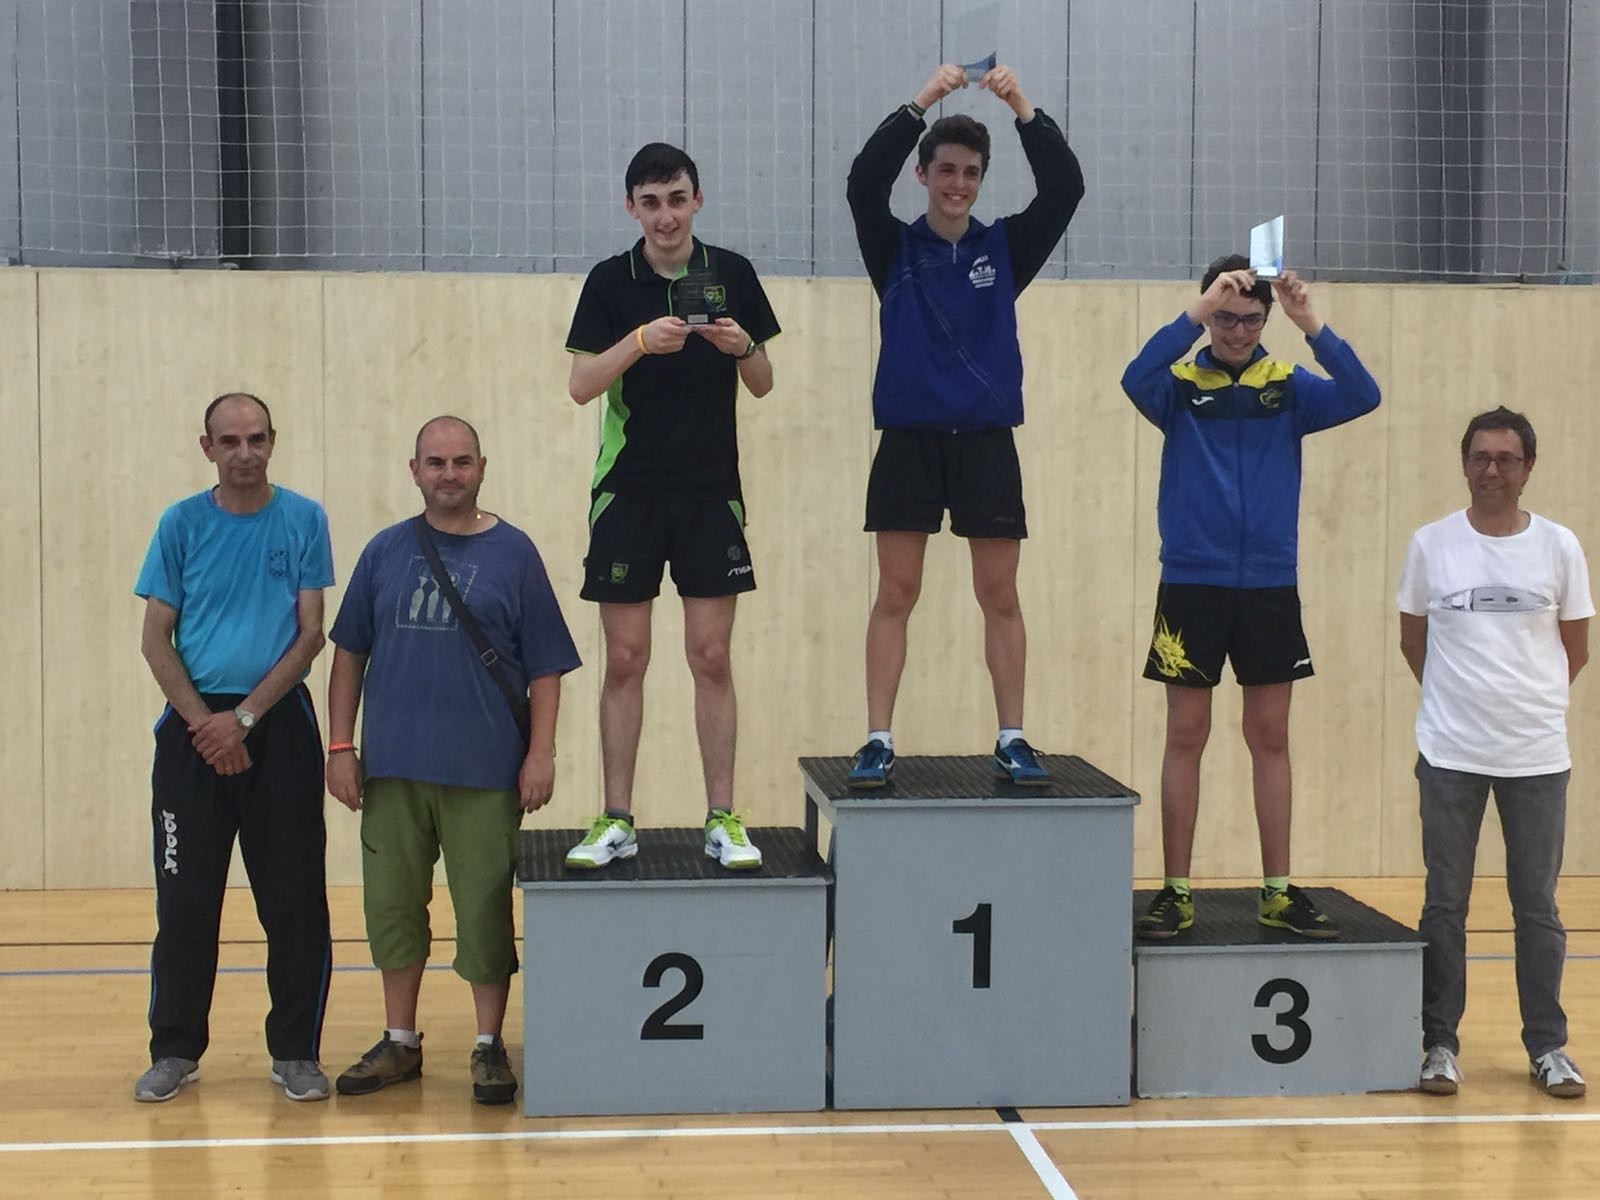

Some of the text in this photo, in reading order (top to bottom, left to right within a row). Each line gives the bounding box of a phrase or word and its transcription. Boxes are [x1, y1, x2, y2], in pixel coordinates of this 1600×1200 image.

[162, 809, 178, 870] JOOLA
[952, 902, 992, 989] 1
[640, 951, 705, 1041] 2
[1250, 977, 1312, 1065] 3
